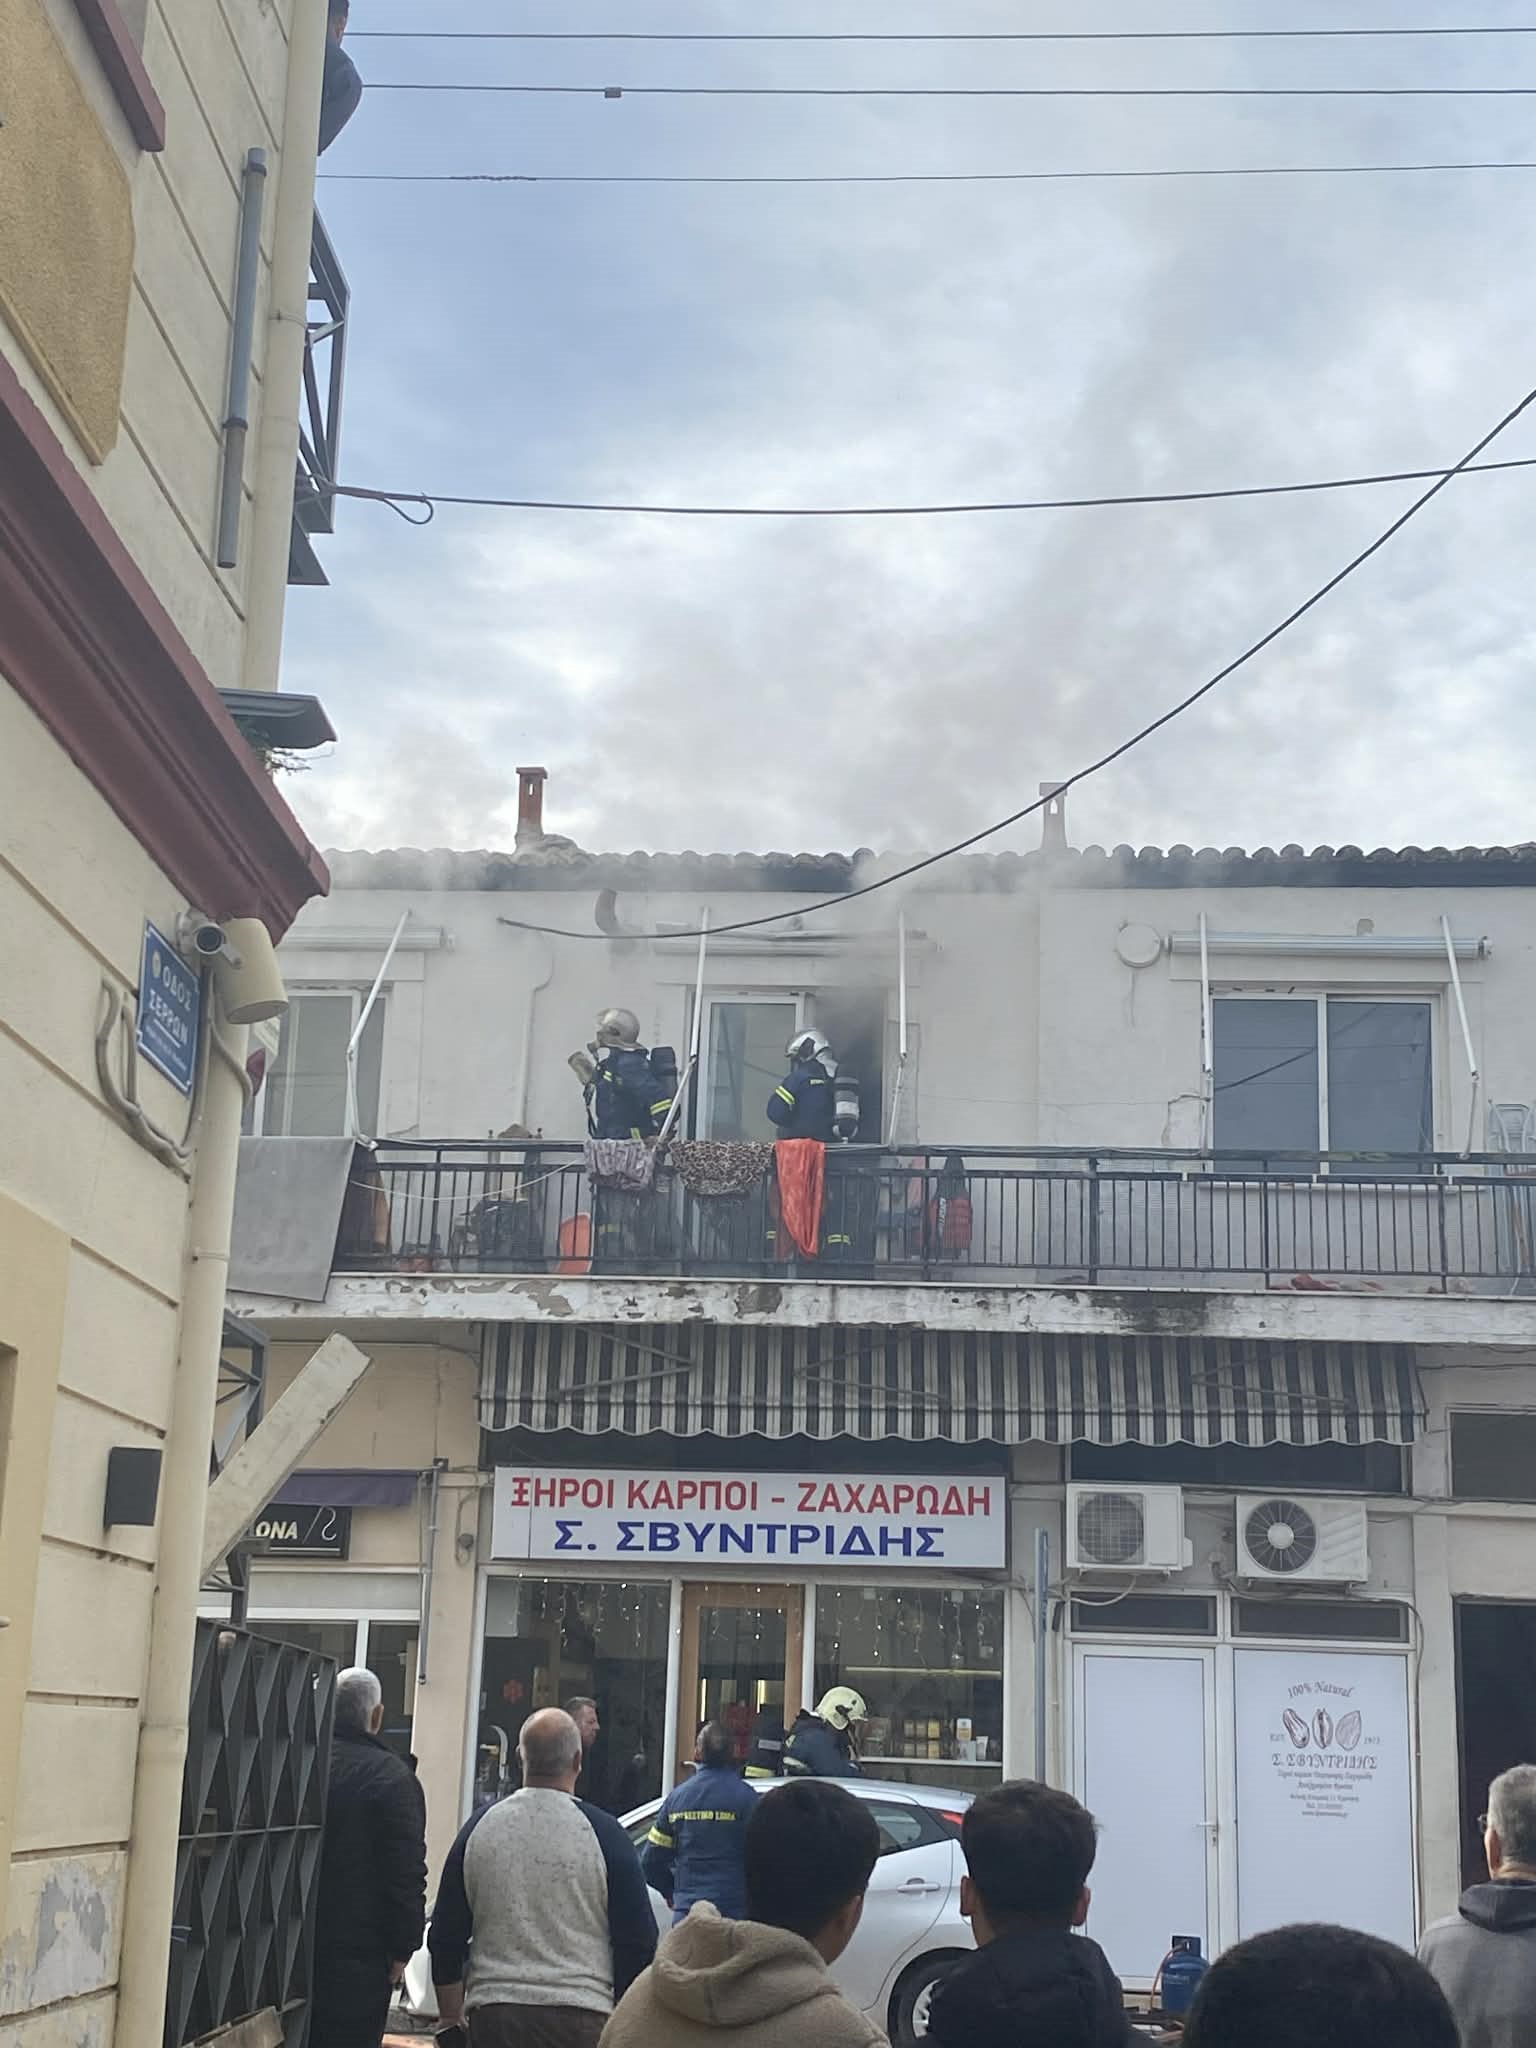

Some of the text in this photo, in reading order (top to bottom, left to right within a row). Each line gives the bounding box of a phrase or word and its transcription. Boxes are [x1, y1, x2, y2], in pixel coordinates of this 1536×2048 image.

[511, 1477, 614, 1508] ΞΗΡΟΙ
[628, 1479, 758, 1511] ΚΑΡΠΟΙ
[798, 1482, 991, 1516] ΖΑΧΑΡΩΔΗ
[554, 1520, 945, 1557] Σ. ΣΒΥΝΤΡΙΔΗΣ
[1288, 1681, 1354, 1699] 100% Natural
[1286, 1753, 1377, 1769] ΣΒΥΝΤΡΙΔΗΣ
